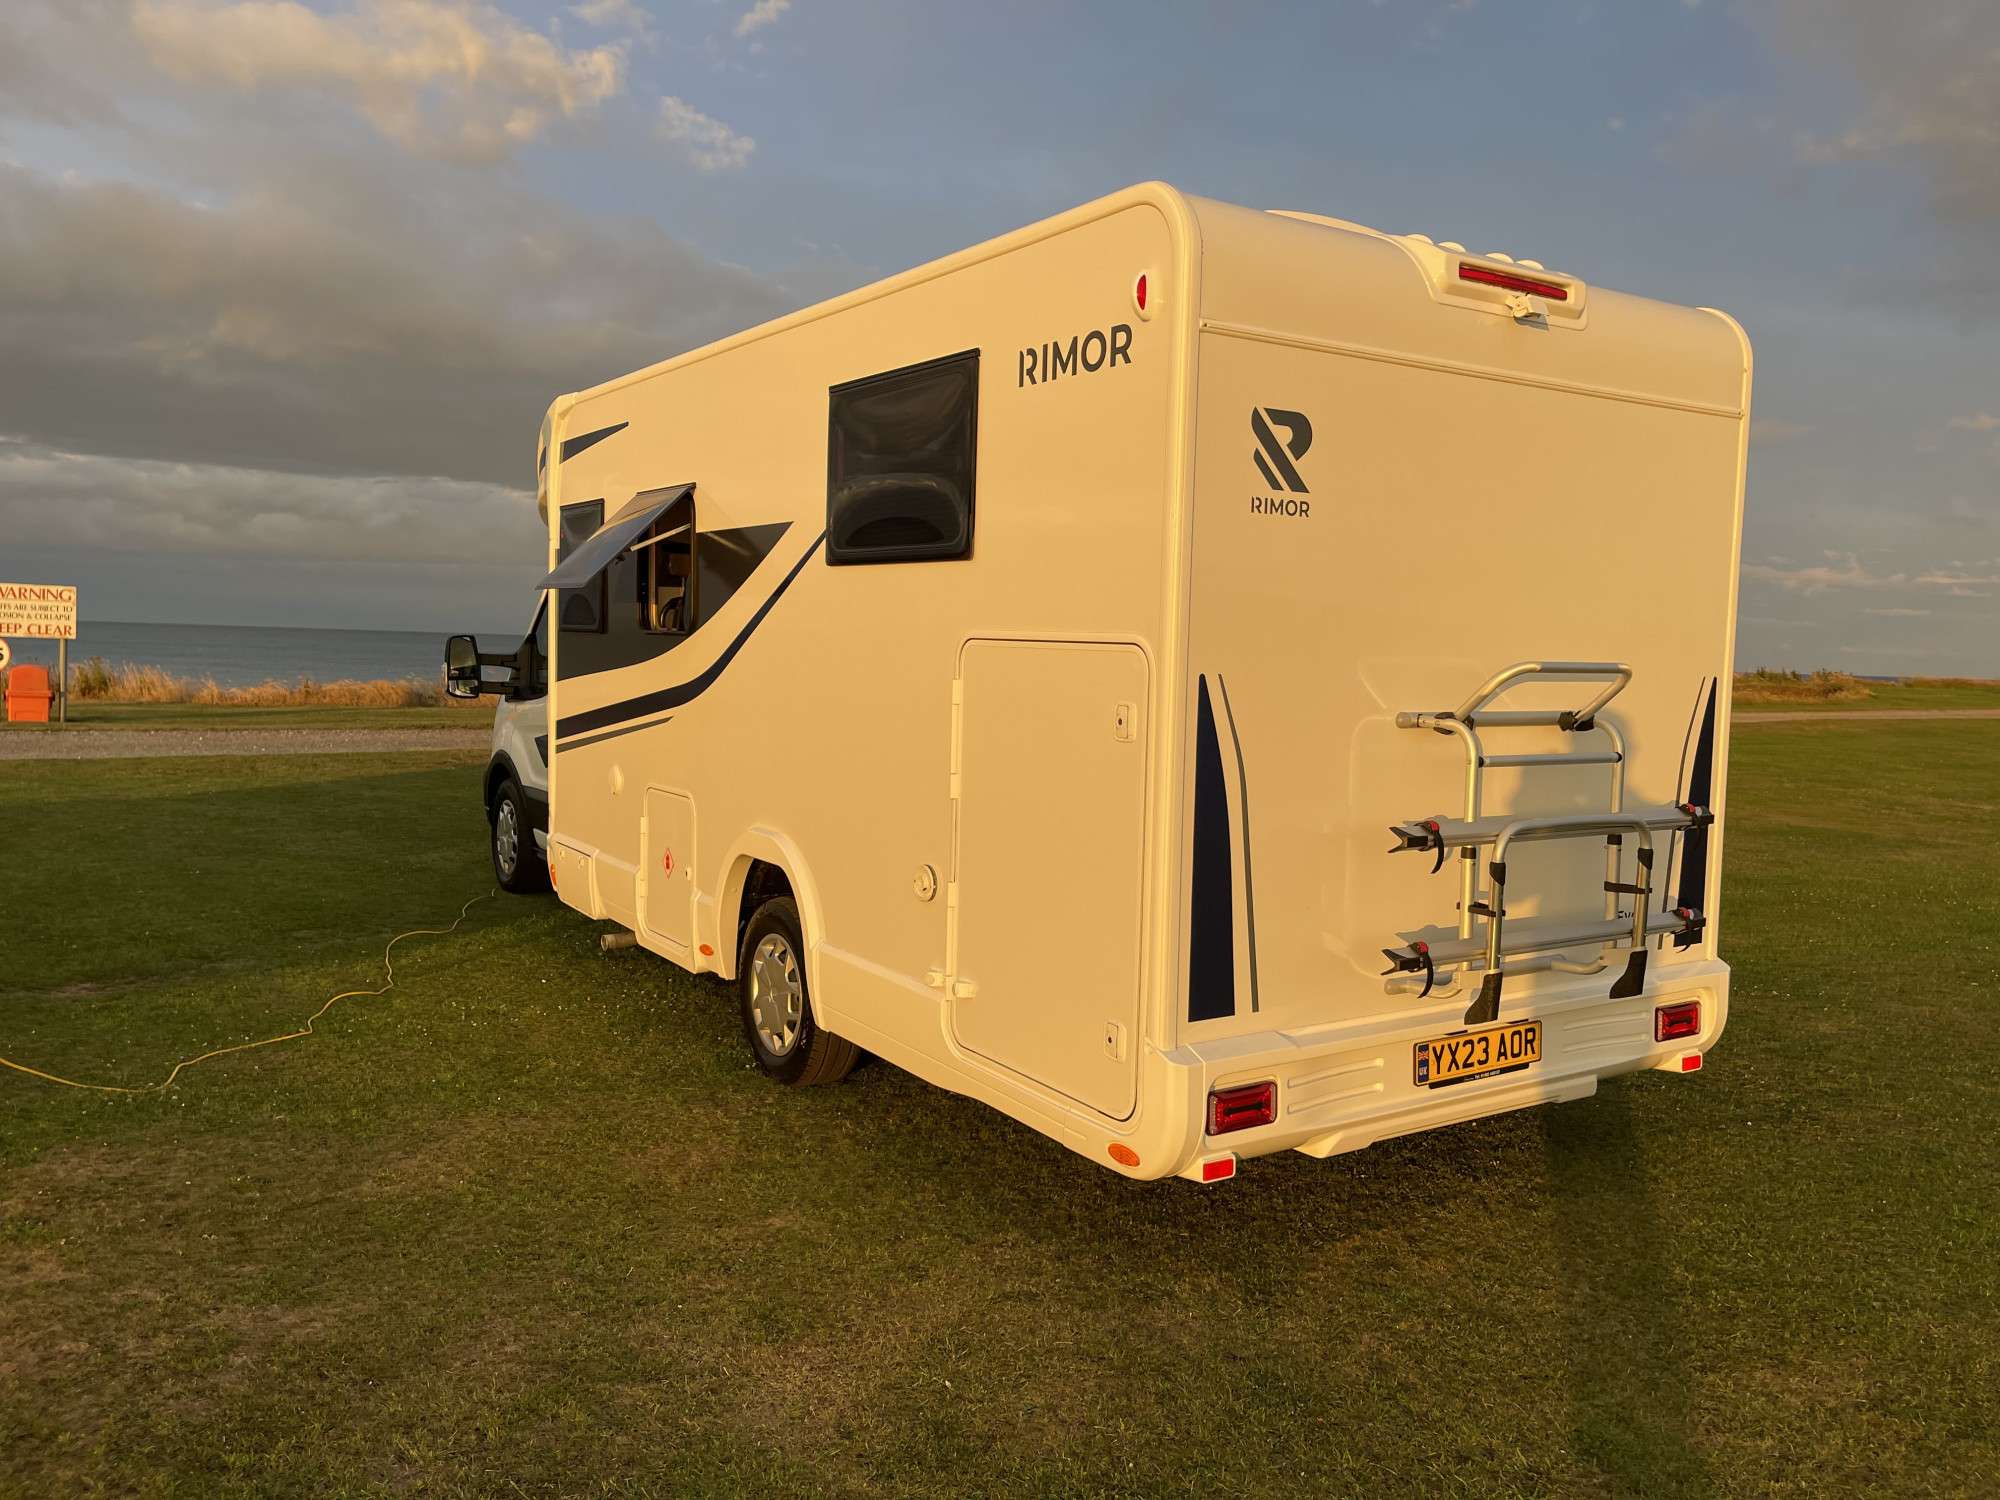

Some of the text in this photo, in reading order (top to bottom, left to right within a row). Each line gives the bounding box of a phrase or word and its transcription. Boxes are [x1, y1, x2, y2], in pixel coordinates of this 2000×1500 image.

[1018, 323, 1133, 388] RIMOR
[1250, 496, 1311, 518] RIMOR
[14, 603, 27, 611] ARE
[34, 613, 70, 621] COLLAPSE
[0, 622, 72, 636] EEP CLEAR
[1431, 1027, 1537, 1075] YX23 AOR
